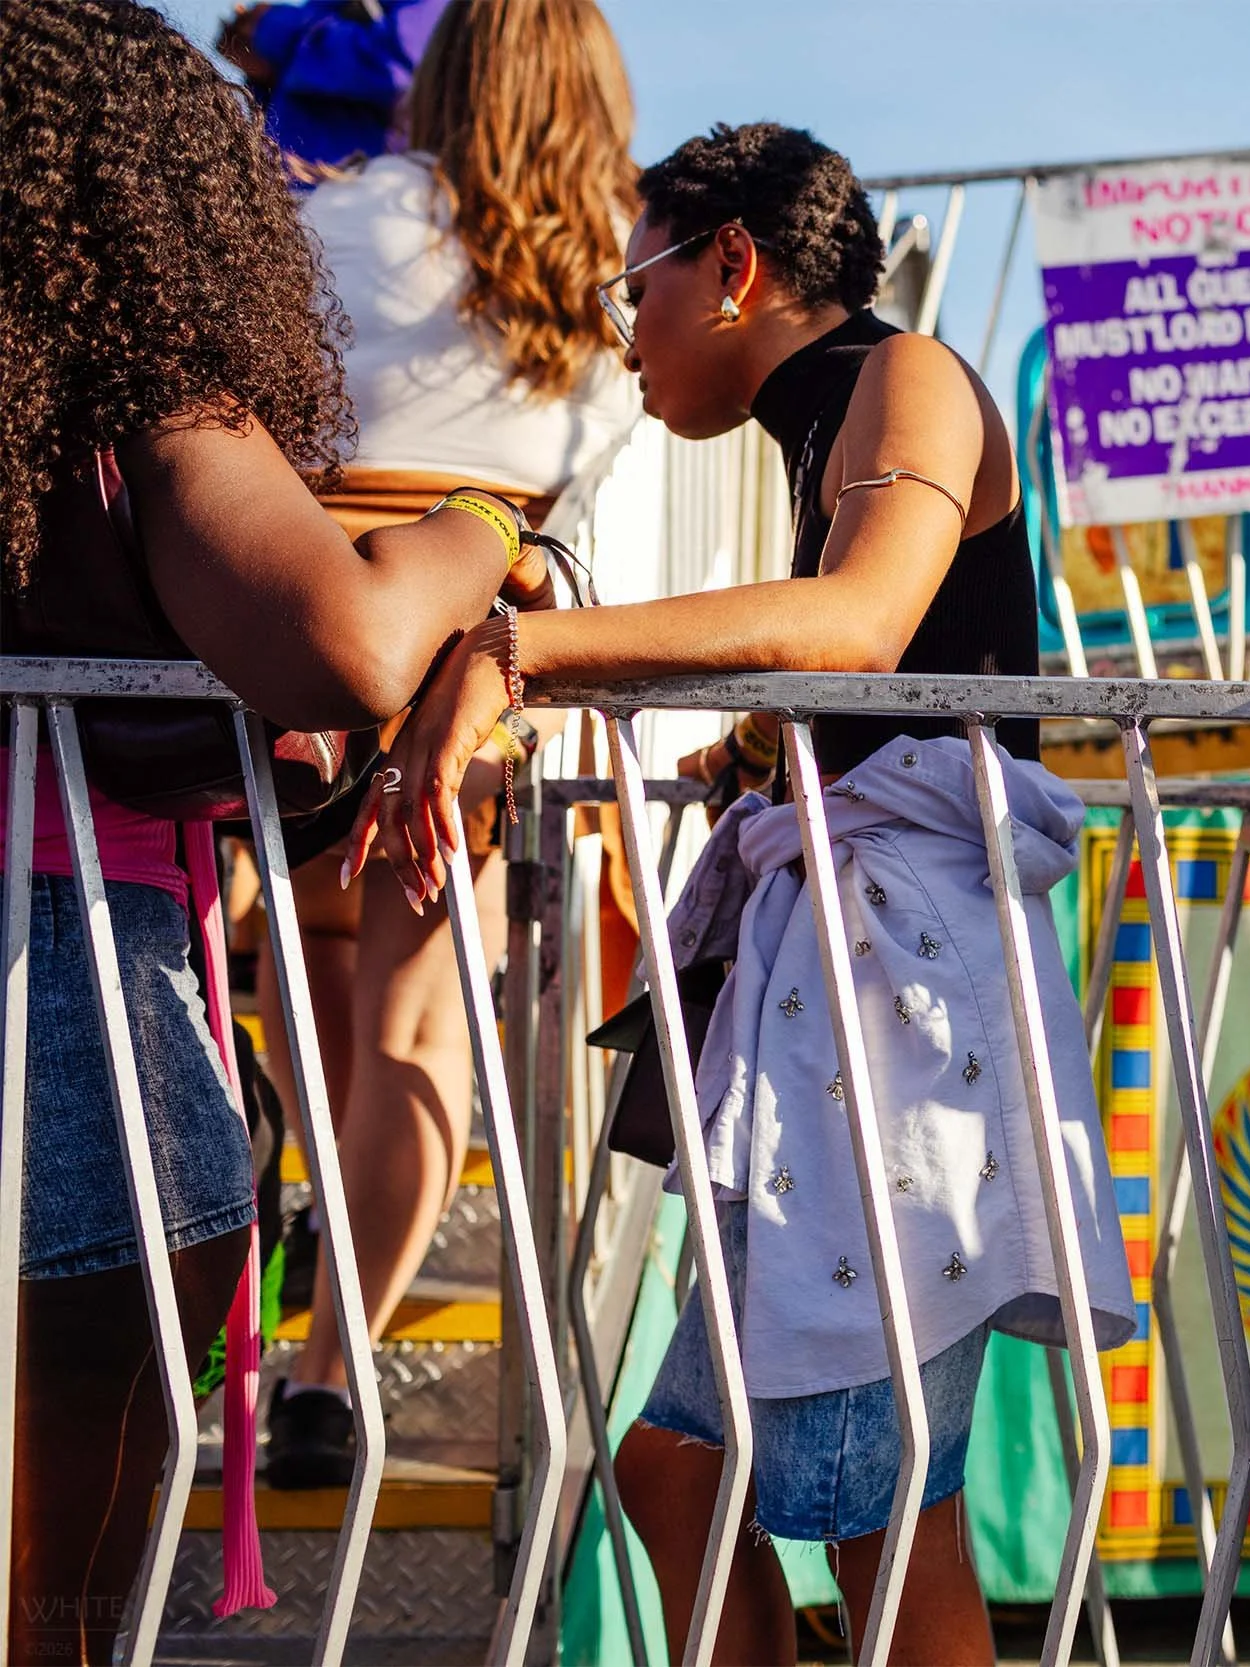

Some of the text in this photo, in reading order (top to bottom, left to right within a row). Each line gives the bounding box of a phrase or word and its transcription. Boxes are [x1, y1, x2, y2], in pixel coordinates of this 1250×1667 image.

[1124, 274, 1186, 313] ALL
[1055, 317, 1147, 360] MUST
[1148, 309, 1244, 352] LOAD
[1128, 363, 1182, 403] NO
[1097, 406, 1152, 448] NO
[493, 515, 510, 537] YOU
